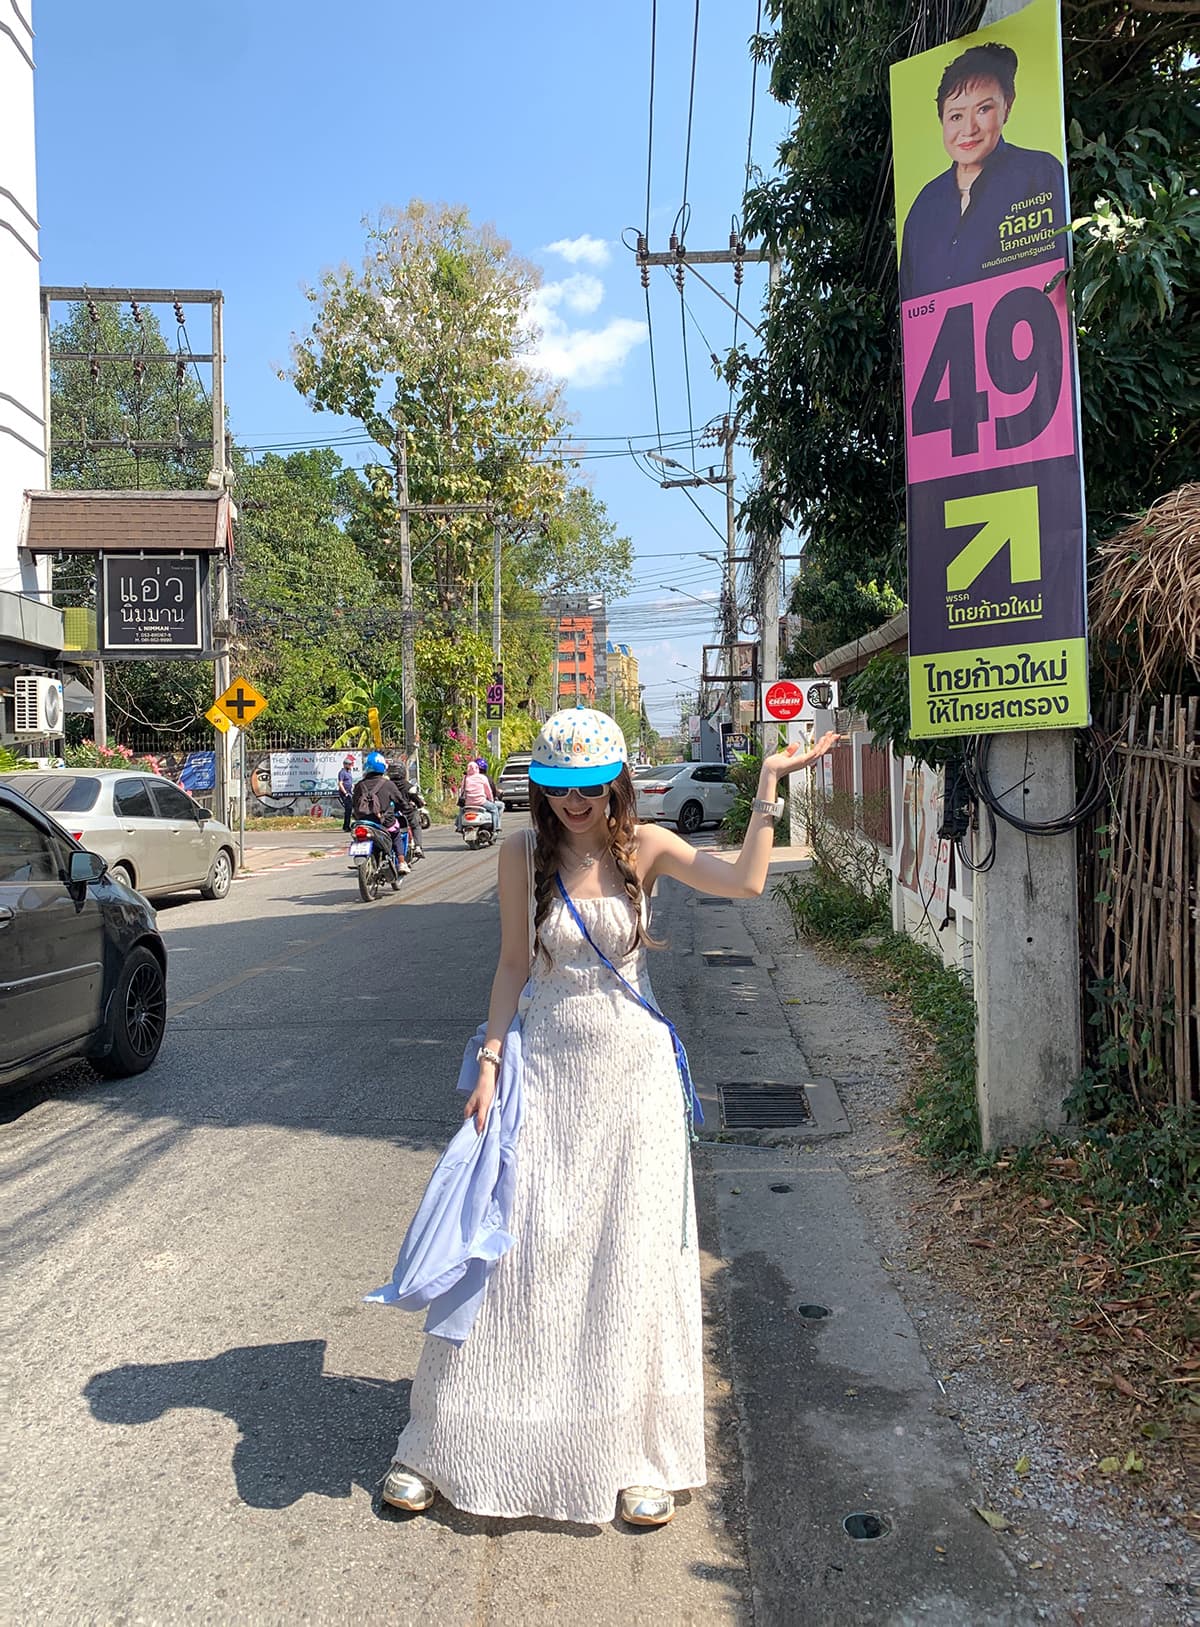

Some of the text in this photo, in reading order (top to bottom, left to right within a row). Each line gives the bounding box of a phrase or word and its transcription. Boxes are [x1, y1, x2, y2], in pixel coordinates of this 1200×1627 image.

[1011, 191, 1053, 213] คุณหญิง
[998, 207, 1053, 238] กัลยา
[908, 300, 936, 319] เบอร์
[911, 286, 1063, 458] 49
[120, 566, 184, 603] แอ่ว
[945, 592, 970, 603] พรรค
[120, 602, 185, 623] นิมมาน
[946, 593, 1043, 623] ไทยก้าวใหม่
[924, 650, 1068, 693] ไทยก้าวใหม่
[488, 686, 503, 702] 49
[927, 695, 1070, 724] ให้ไทยสตรอง
